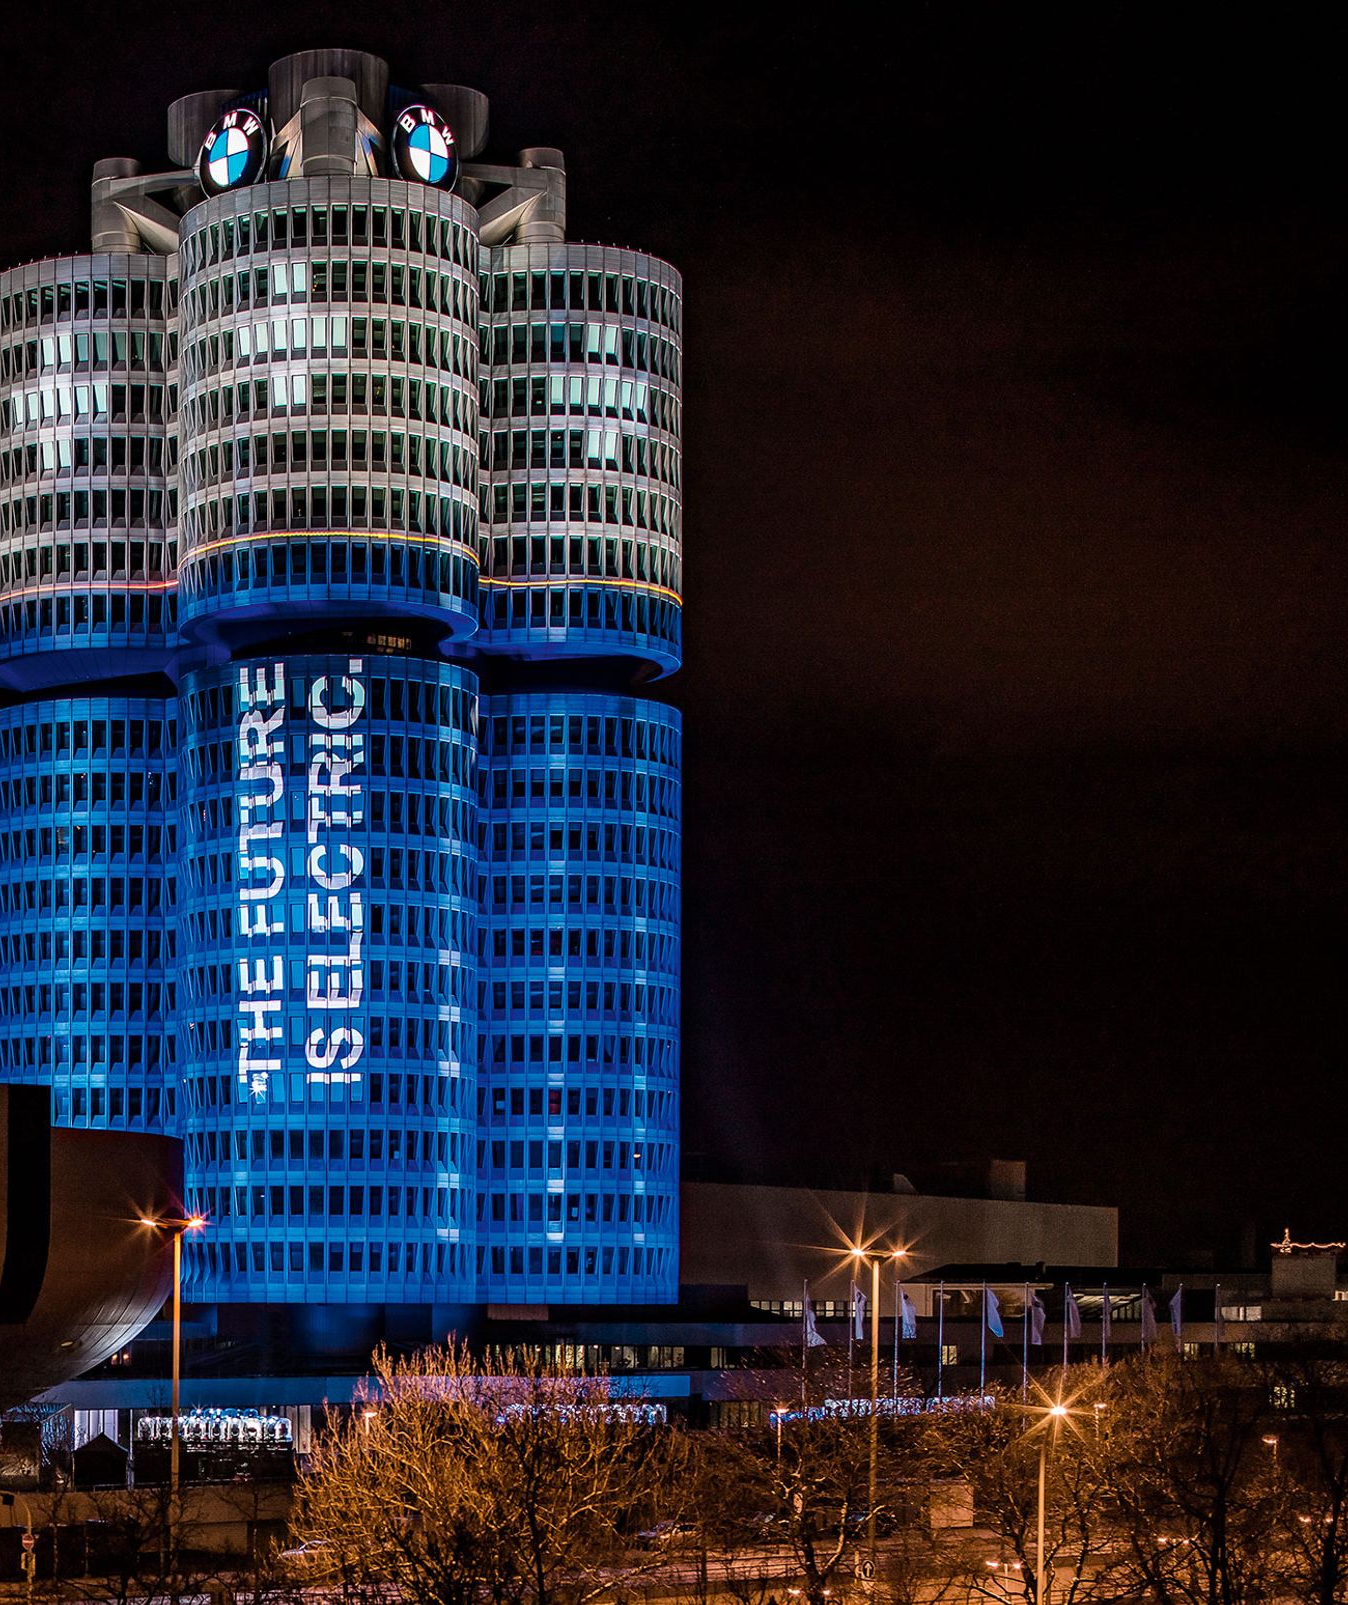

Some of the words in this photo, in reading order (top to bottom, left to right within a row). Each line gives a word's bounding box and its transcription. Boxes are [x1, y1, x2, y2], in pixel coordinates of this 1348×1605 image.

[205, 112, 259, 150] BMW
[400, 109, 454, 145] BMW
[238, 663, 285, 937] FUTURE
[307, 659, 365, 1009] ELECTRIC.
[239, 956, 284, 1083] THE
[305, 1027, 364, 1084] IS
